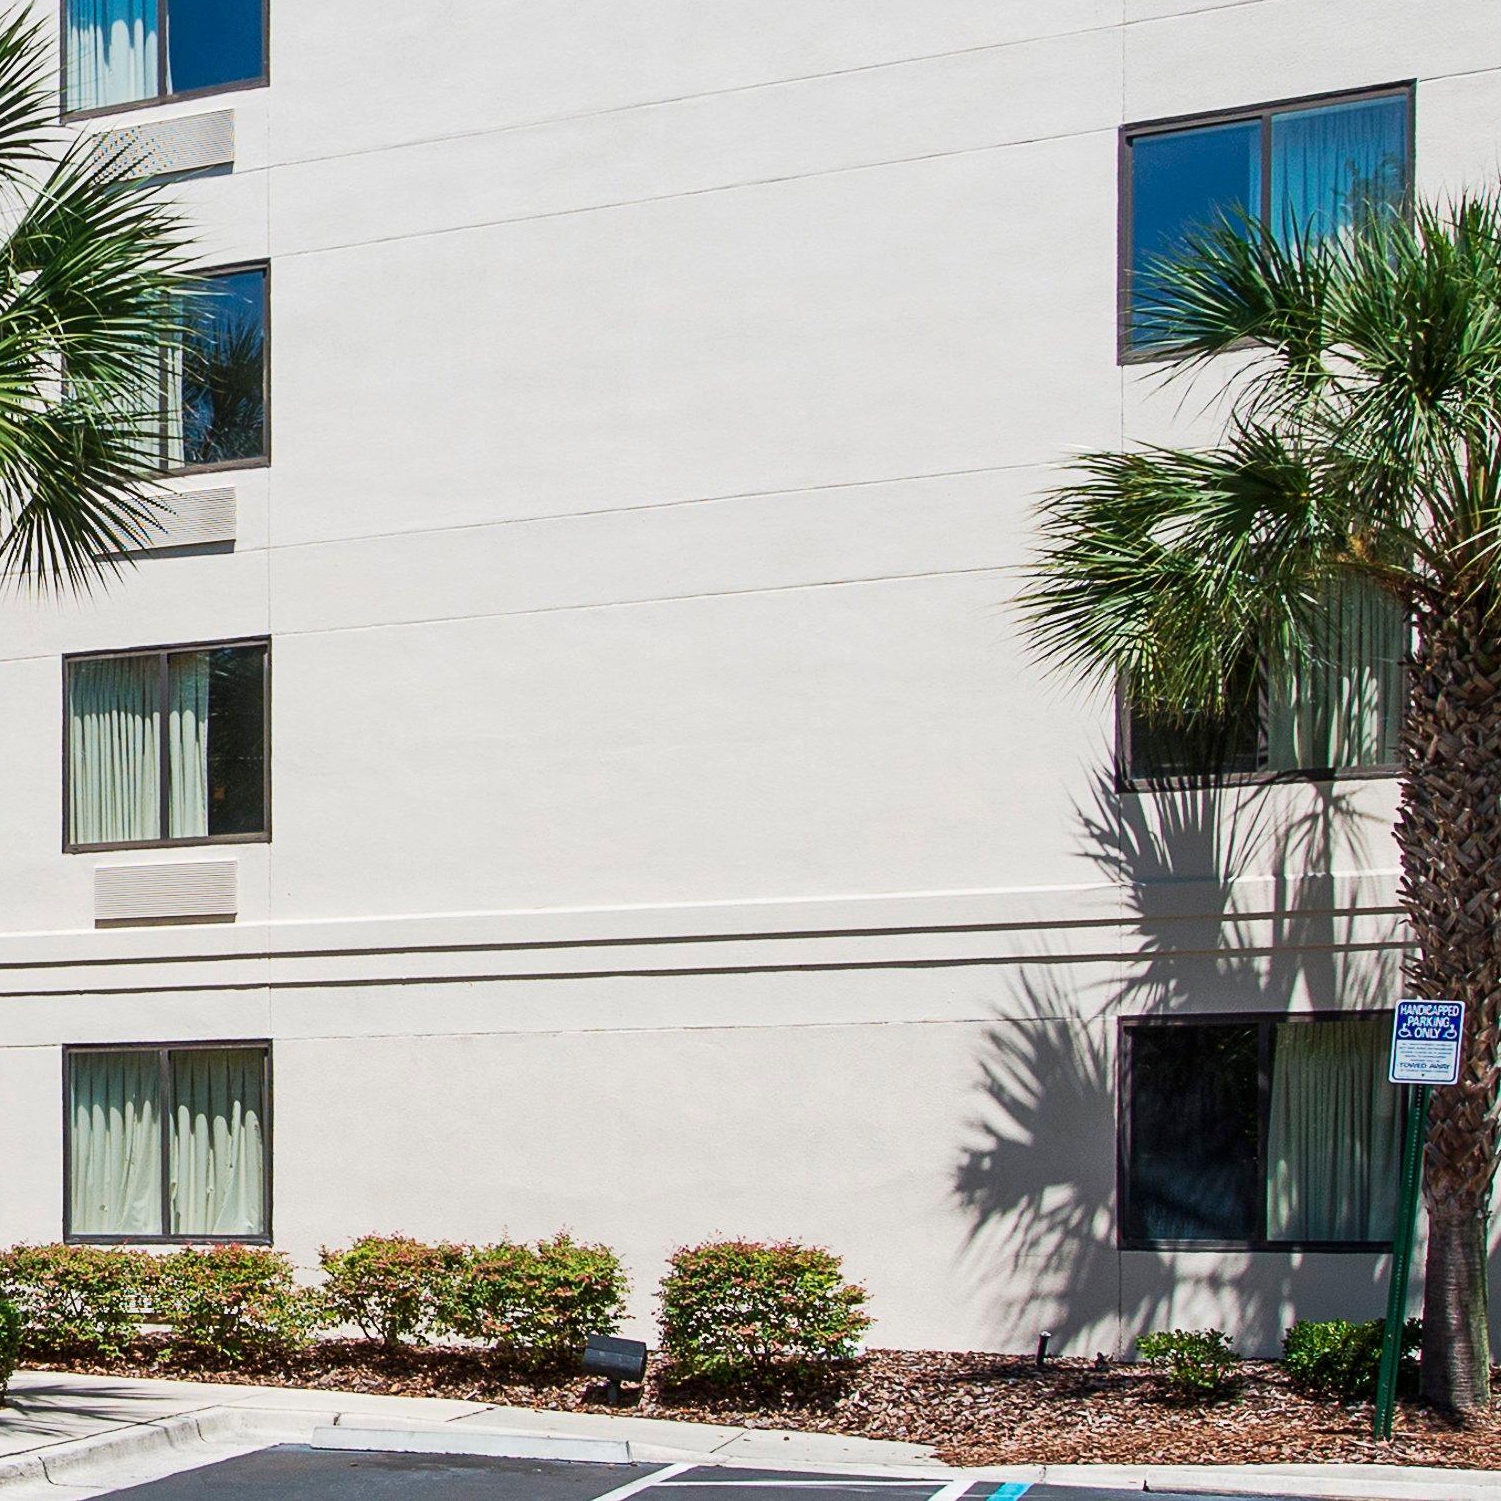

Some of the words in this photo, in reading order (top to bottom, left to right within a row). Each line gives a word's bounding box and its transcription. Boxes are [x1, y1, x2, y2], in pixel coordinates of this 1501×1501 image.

[1400, 1004, 1460, 1017] HANDICAPPED
[1407, 1016, 1450, 1027] PARKING
[1414, 1028, 1441, 1039] ONLY
